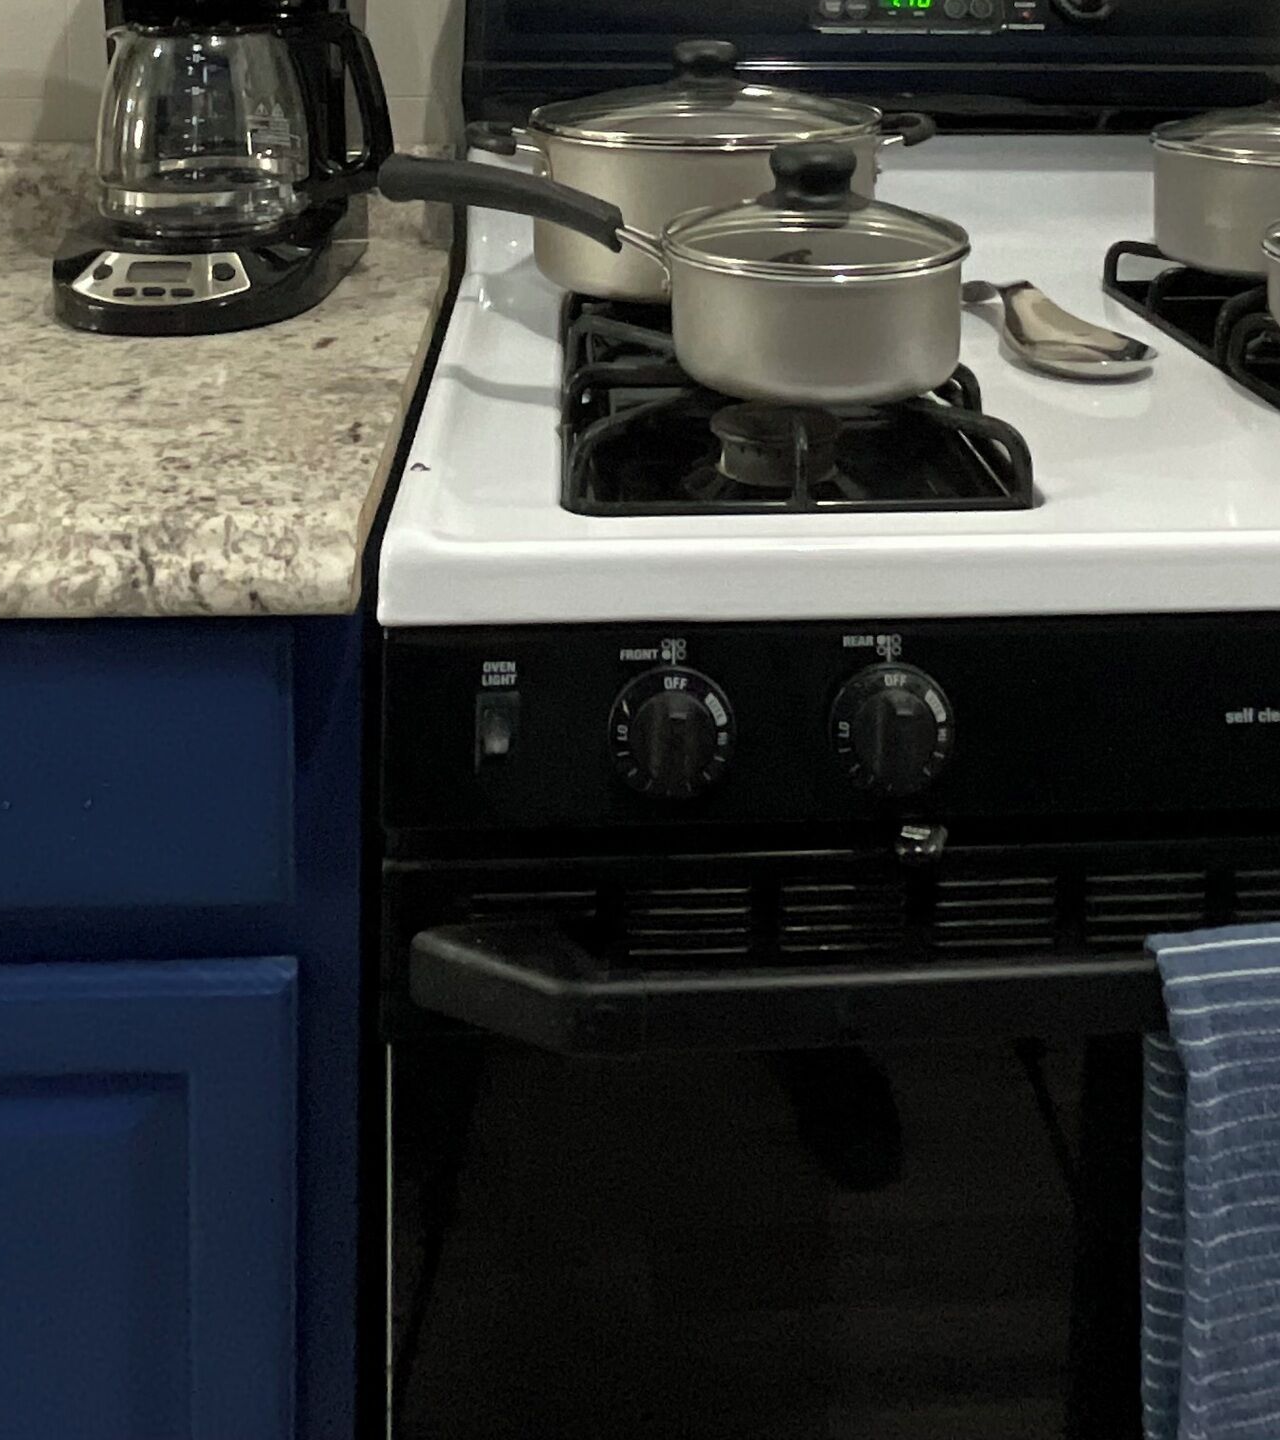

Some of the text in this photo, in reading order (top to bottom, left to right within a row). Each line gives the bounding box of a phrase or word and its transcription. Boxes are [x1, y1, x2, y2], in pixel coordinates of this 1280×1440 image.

[842, 635, 874, 647] REAR
[619, 648, 659, 661] FRONT
[482, 661, 516, 673] OVEN
[481, 673, 517, 687] LIGHT
[663, 676, 688, 690] OFF
[884, 674, 907, 687] OFF
[1225, 708, 1253, 724] self
